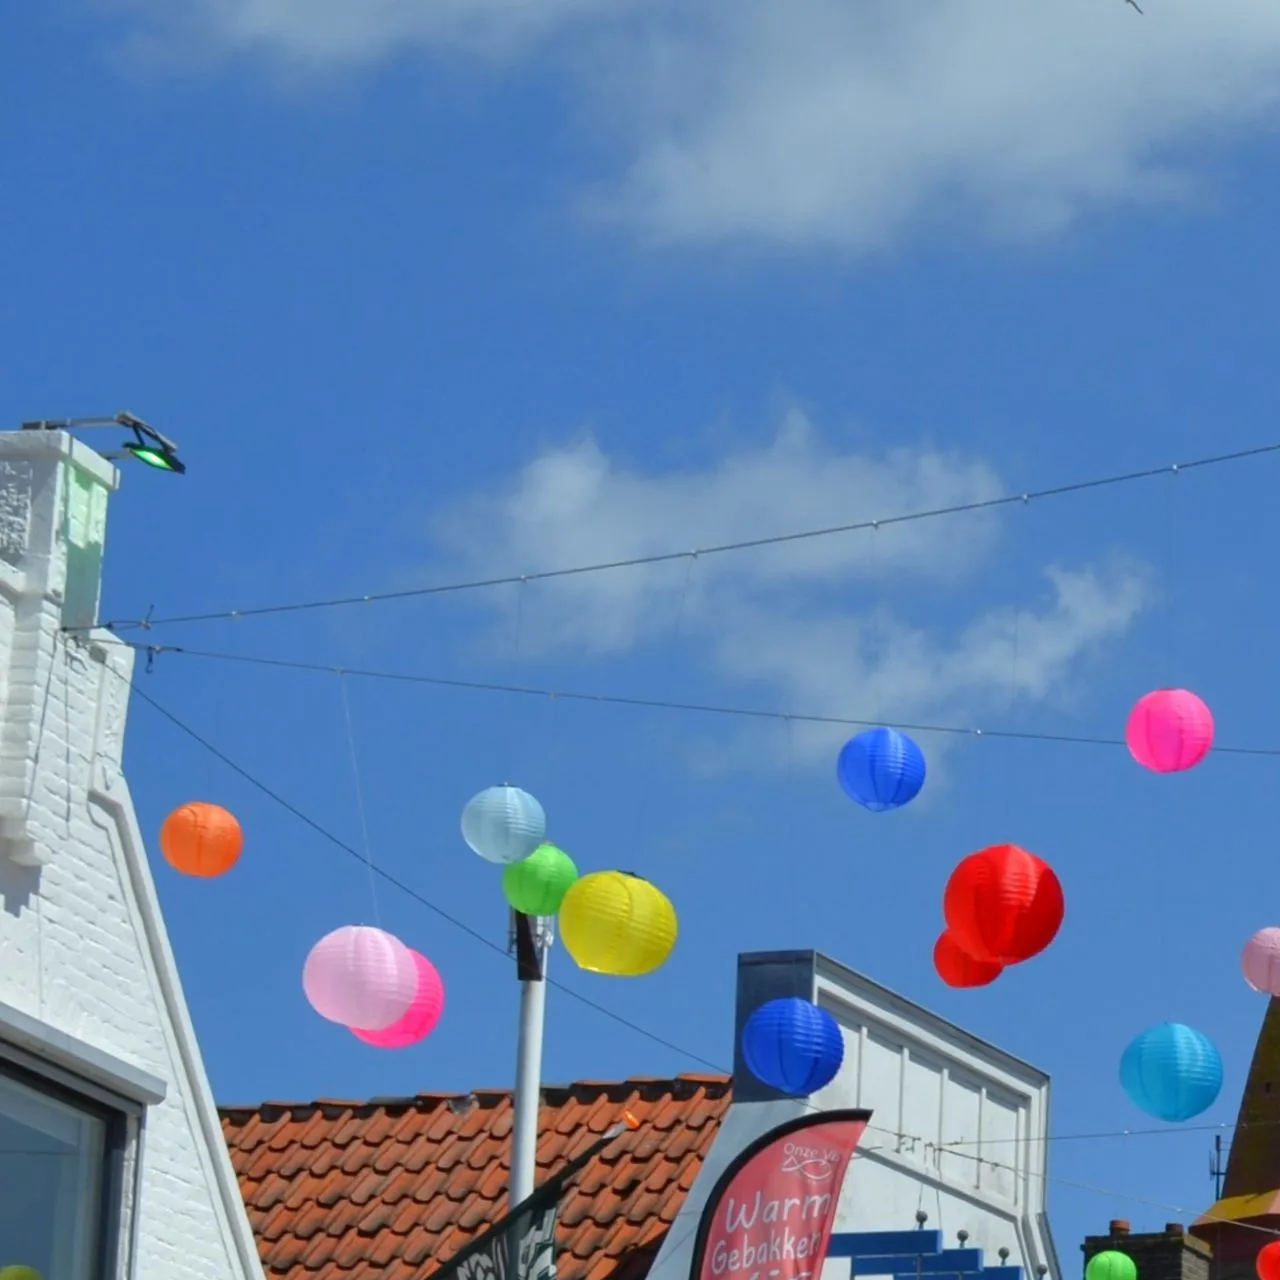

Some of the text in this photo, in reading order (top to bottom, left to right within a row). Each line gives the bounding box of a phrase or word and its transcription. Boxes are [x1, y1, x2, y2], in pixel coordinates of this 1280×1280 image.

[783, 1142, 819, 1161] Onze
[725, 1191, 832, 1233] Warm
[711, 1228, 822, 1275] Gebakken
